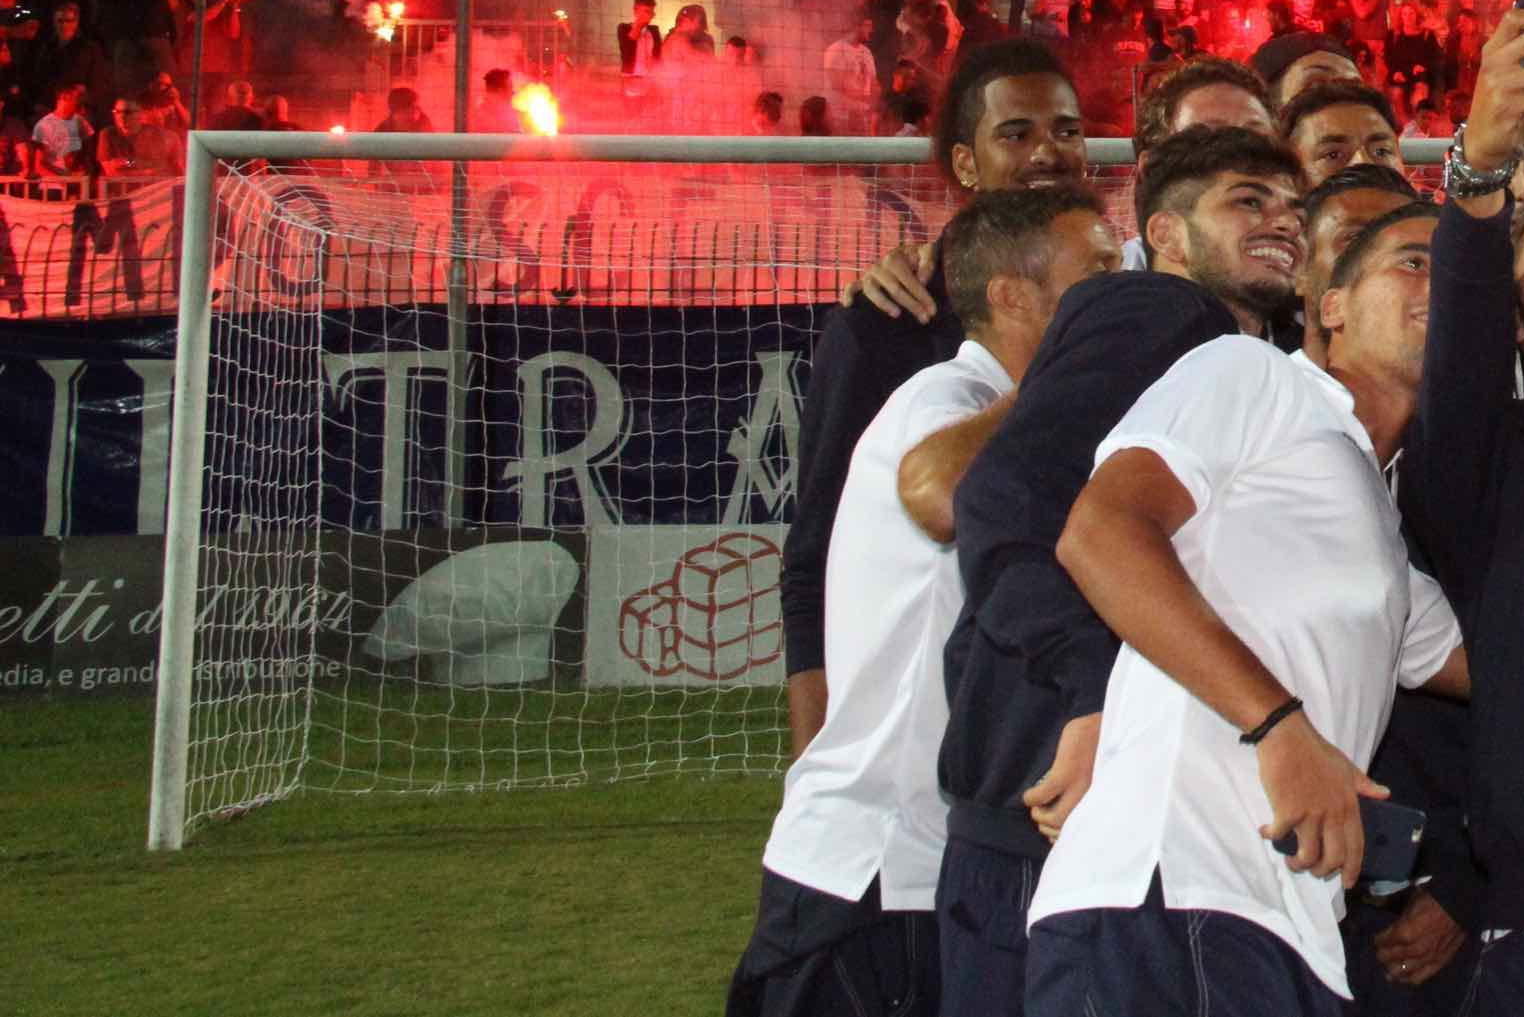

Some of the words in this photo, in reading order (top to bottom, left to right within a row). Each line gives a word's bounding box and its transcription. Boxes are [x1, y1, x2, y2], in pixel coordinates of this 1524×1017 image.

[0, 664, 50, 688] dia,
[58, 668, 74, 685] e
[80, 660, 160, 690] grand
